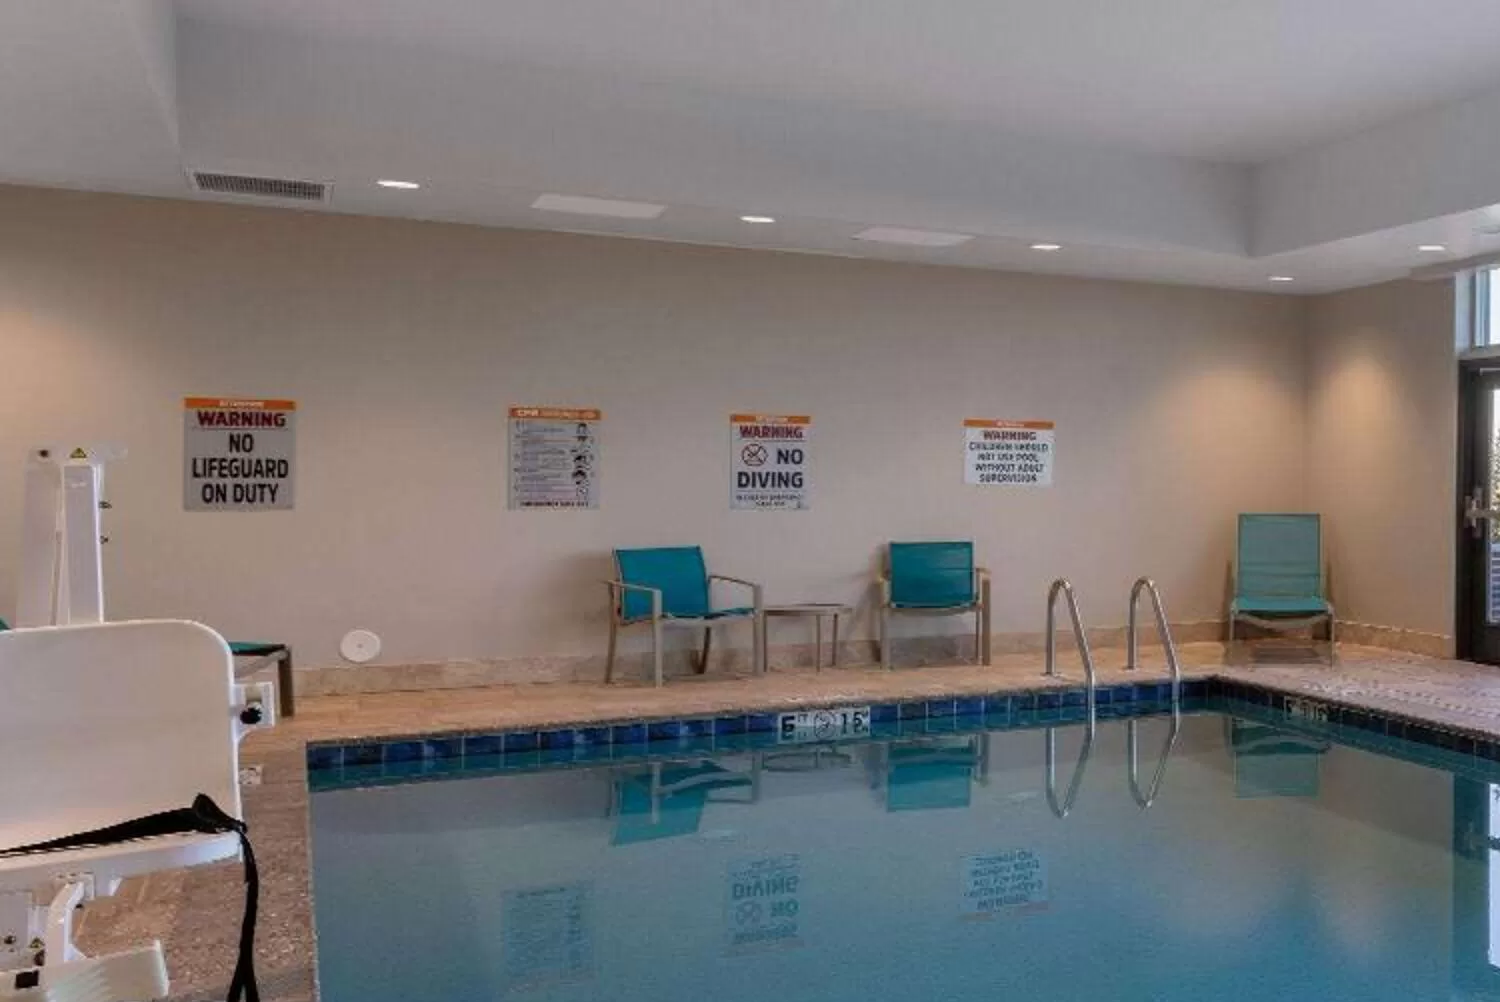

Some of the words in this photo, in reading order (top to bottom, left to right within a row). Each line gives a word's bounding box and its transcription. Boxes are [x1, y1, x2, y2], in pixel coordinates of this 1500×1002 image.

[197, 410, 287, 428] WARNING
[740, 425, 803, 439] WARNING
[983, 431, 1037, 441] WARNING
[229, 433, 255, 453] NO
[777, 449, 804, 465] NO
[192, 458, 289, 479] LIFEGUARD
[737, 471, 804, 489] DIVING
[202, 483, 227, 504] ON
[233, 483, 279, 504] DUTY
